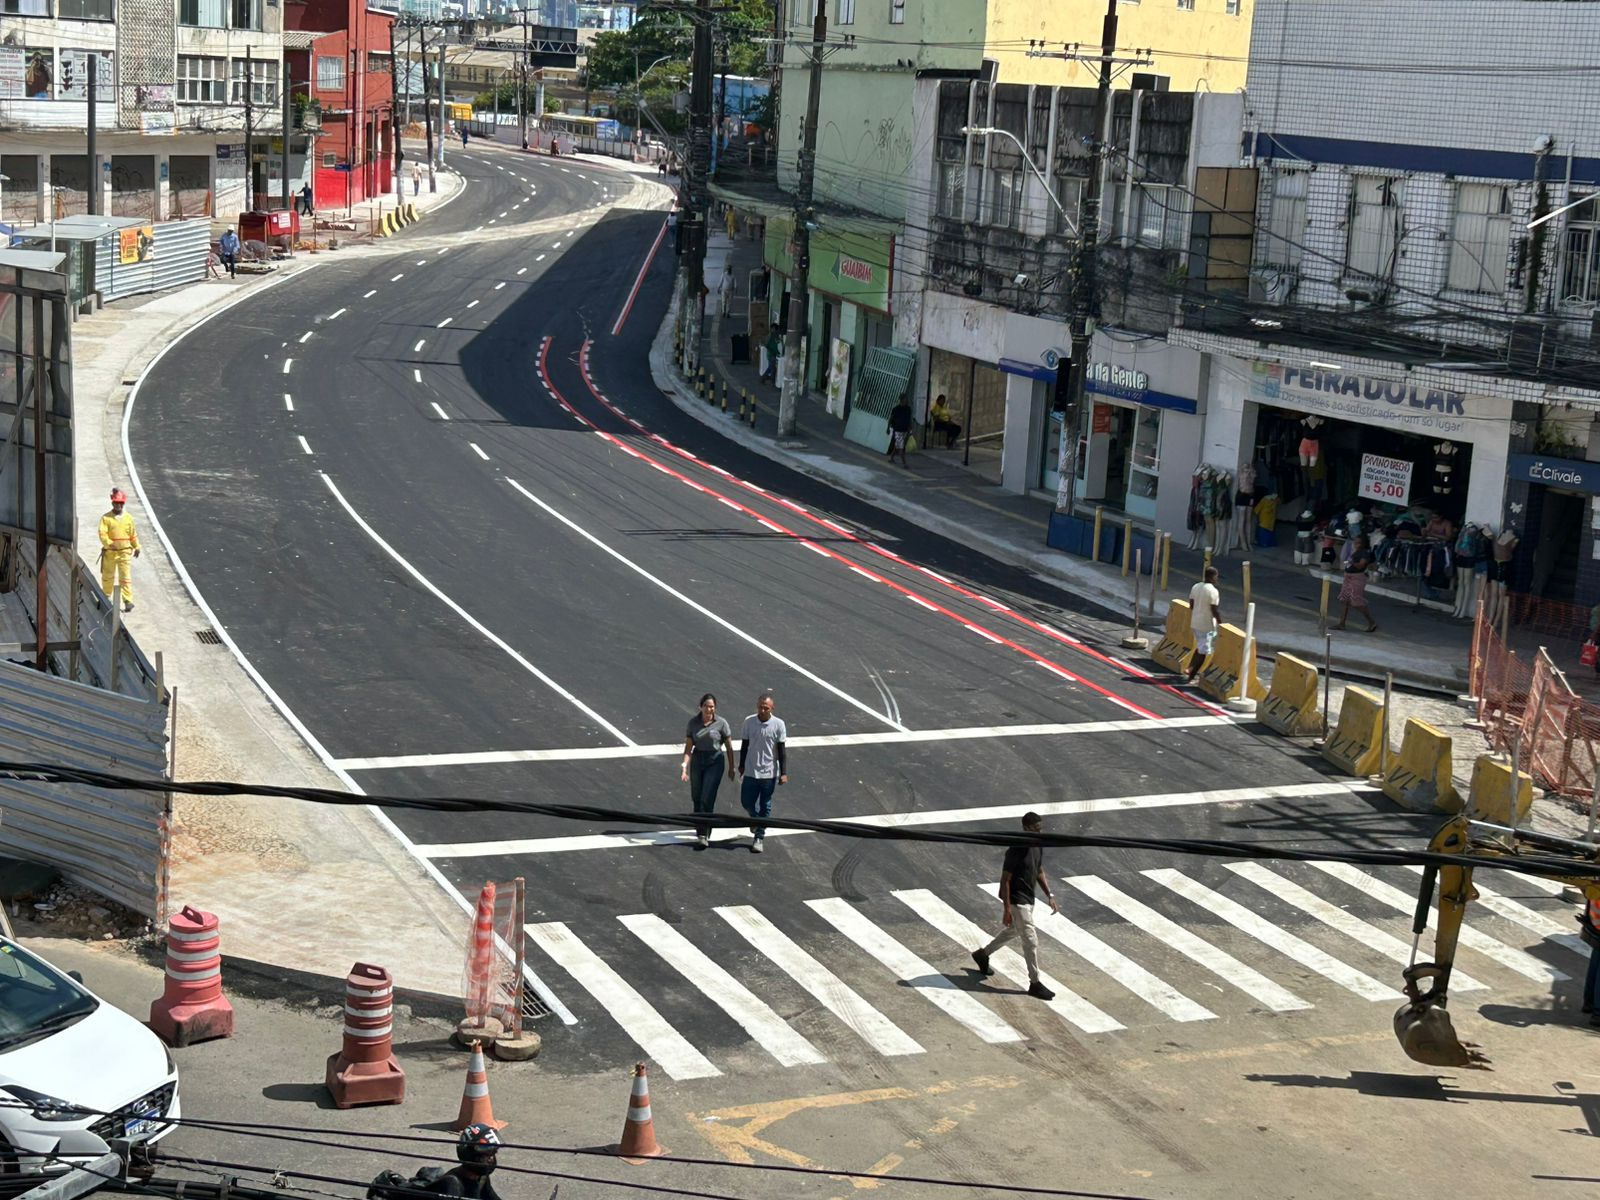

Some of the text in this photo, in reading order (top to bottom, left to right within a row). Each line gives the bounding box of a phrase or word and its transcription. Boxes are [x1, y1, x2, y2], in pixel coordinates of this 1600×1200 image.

[1111, 365, 1146, 390] Gente
[1373, 481, 1404, 498] 5,00
[1263, 696, 1299, 722] VLT
[1328, 730, 1369, 761] VLT
